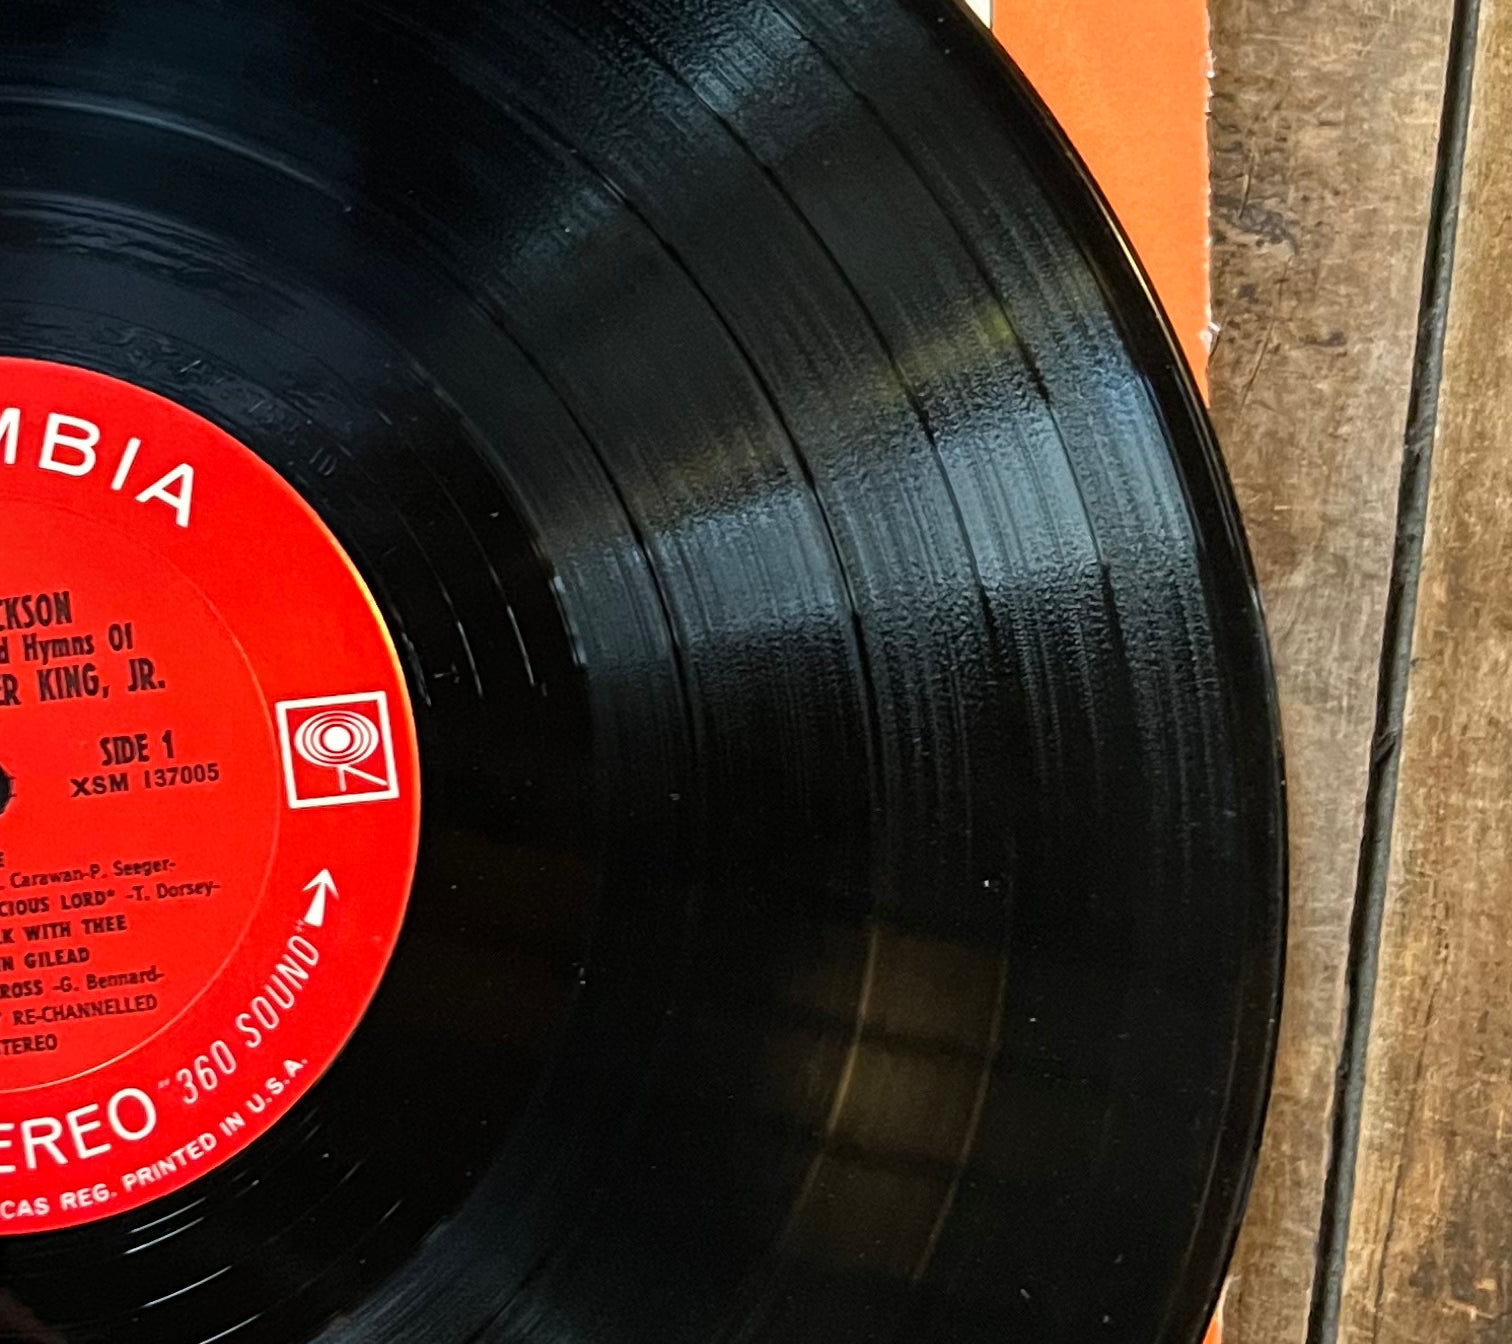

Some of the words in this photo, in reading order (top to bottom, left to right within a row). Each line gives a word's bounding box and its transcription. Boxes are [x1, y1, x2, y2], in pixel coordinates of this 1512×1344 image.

[22, 630, 95, 664] Hymns
[107, 622, 133, 652] Of
[36, 663, 111, 703] KING,
[126, 656, 166, 693] JR.
[99, 732, 150, 768] SIDE
[161, 728, 177, 760] 1
[70, 772, 130, 798] XSM
[143, 762, 221, 789] 137005
[9, 863, 109, 889] Carawan-P.
[112, 858, 177, 878] Seeger-
[23, 920, 72, 942] WITH
[81, 914, 129, 936] THEE
[23, 946, 91, 970] GILEAD
[12, 993, 159, 1027] RE-CHANNELLED
[59, 1182, 118, 1211] REG.
[121, 1131, 218, 1192] PRINTED
[219, 1111, 247, 1137] IN
[246, 1057, 309, 1115] U.S.A.
